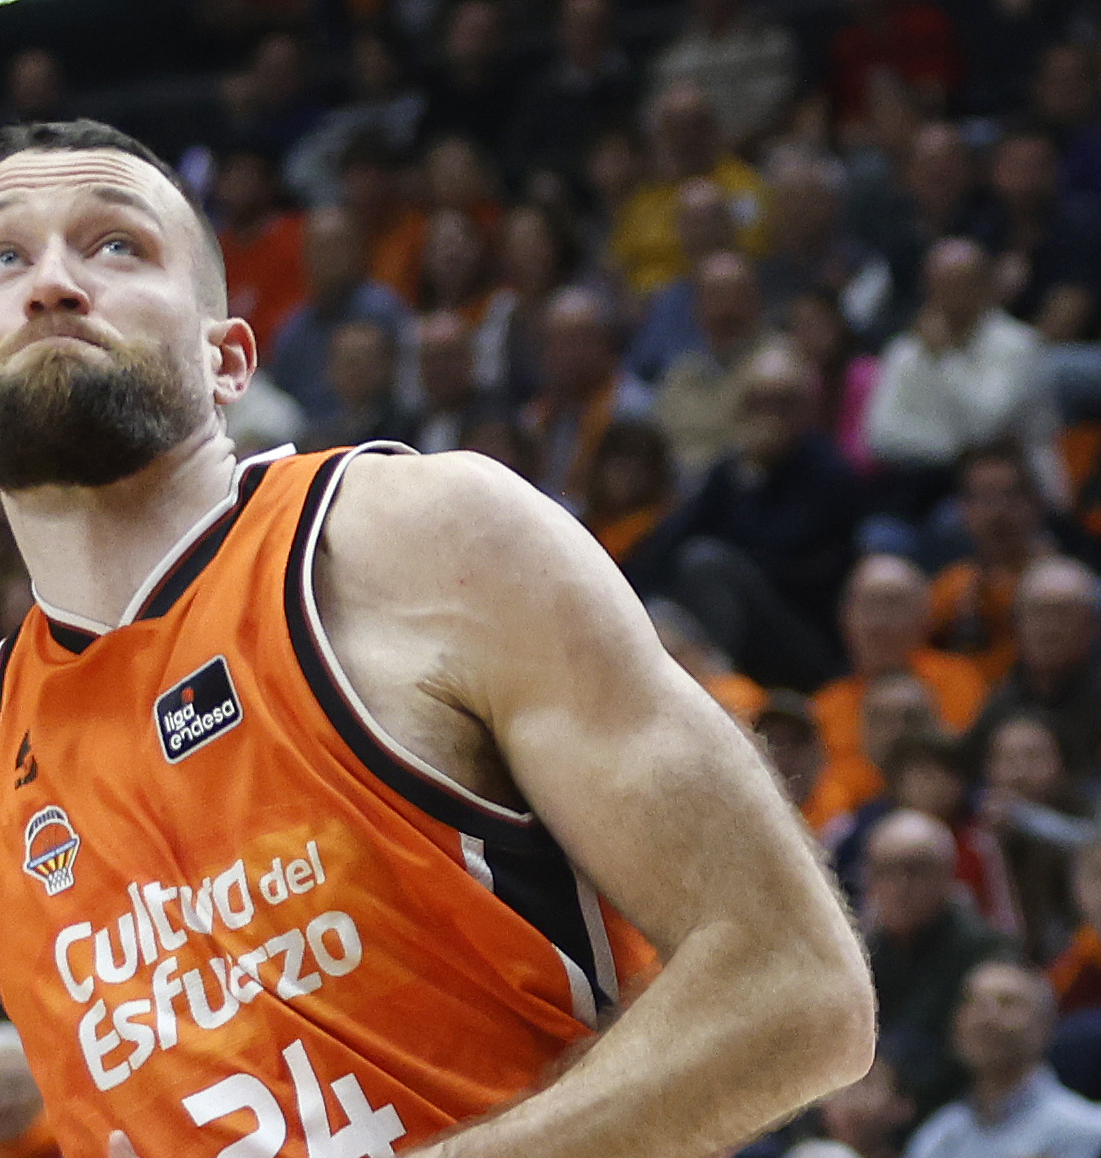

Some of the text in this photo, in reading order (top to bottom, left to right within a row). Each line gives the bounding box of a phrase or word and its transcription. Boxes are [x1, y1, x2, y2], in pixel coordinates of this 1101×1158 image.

[163, 702, 195, 733] liga
[170, 698, 236, 750] endesa
[259, 840, 326, 905] del
[79, 910, 363, 1091] Esfuerzo
